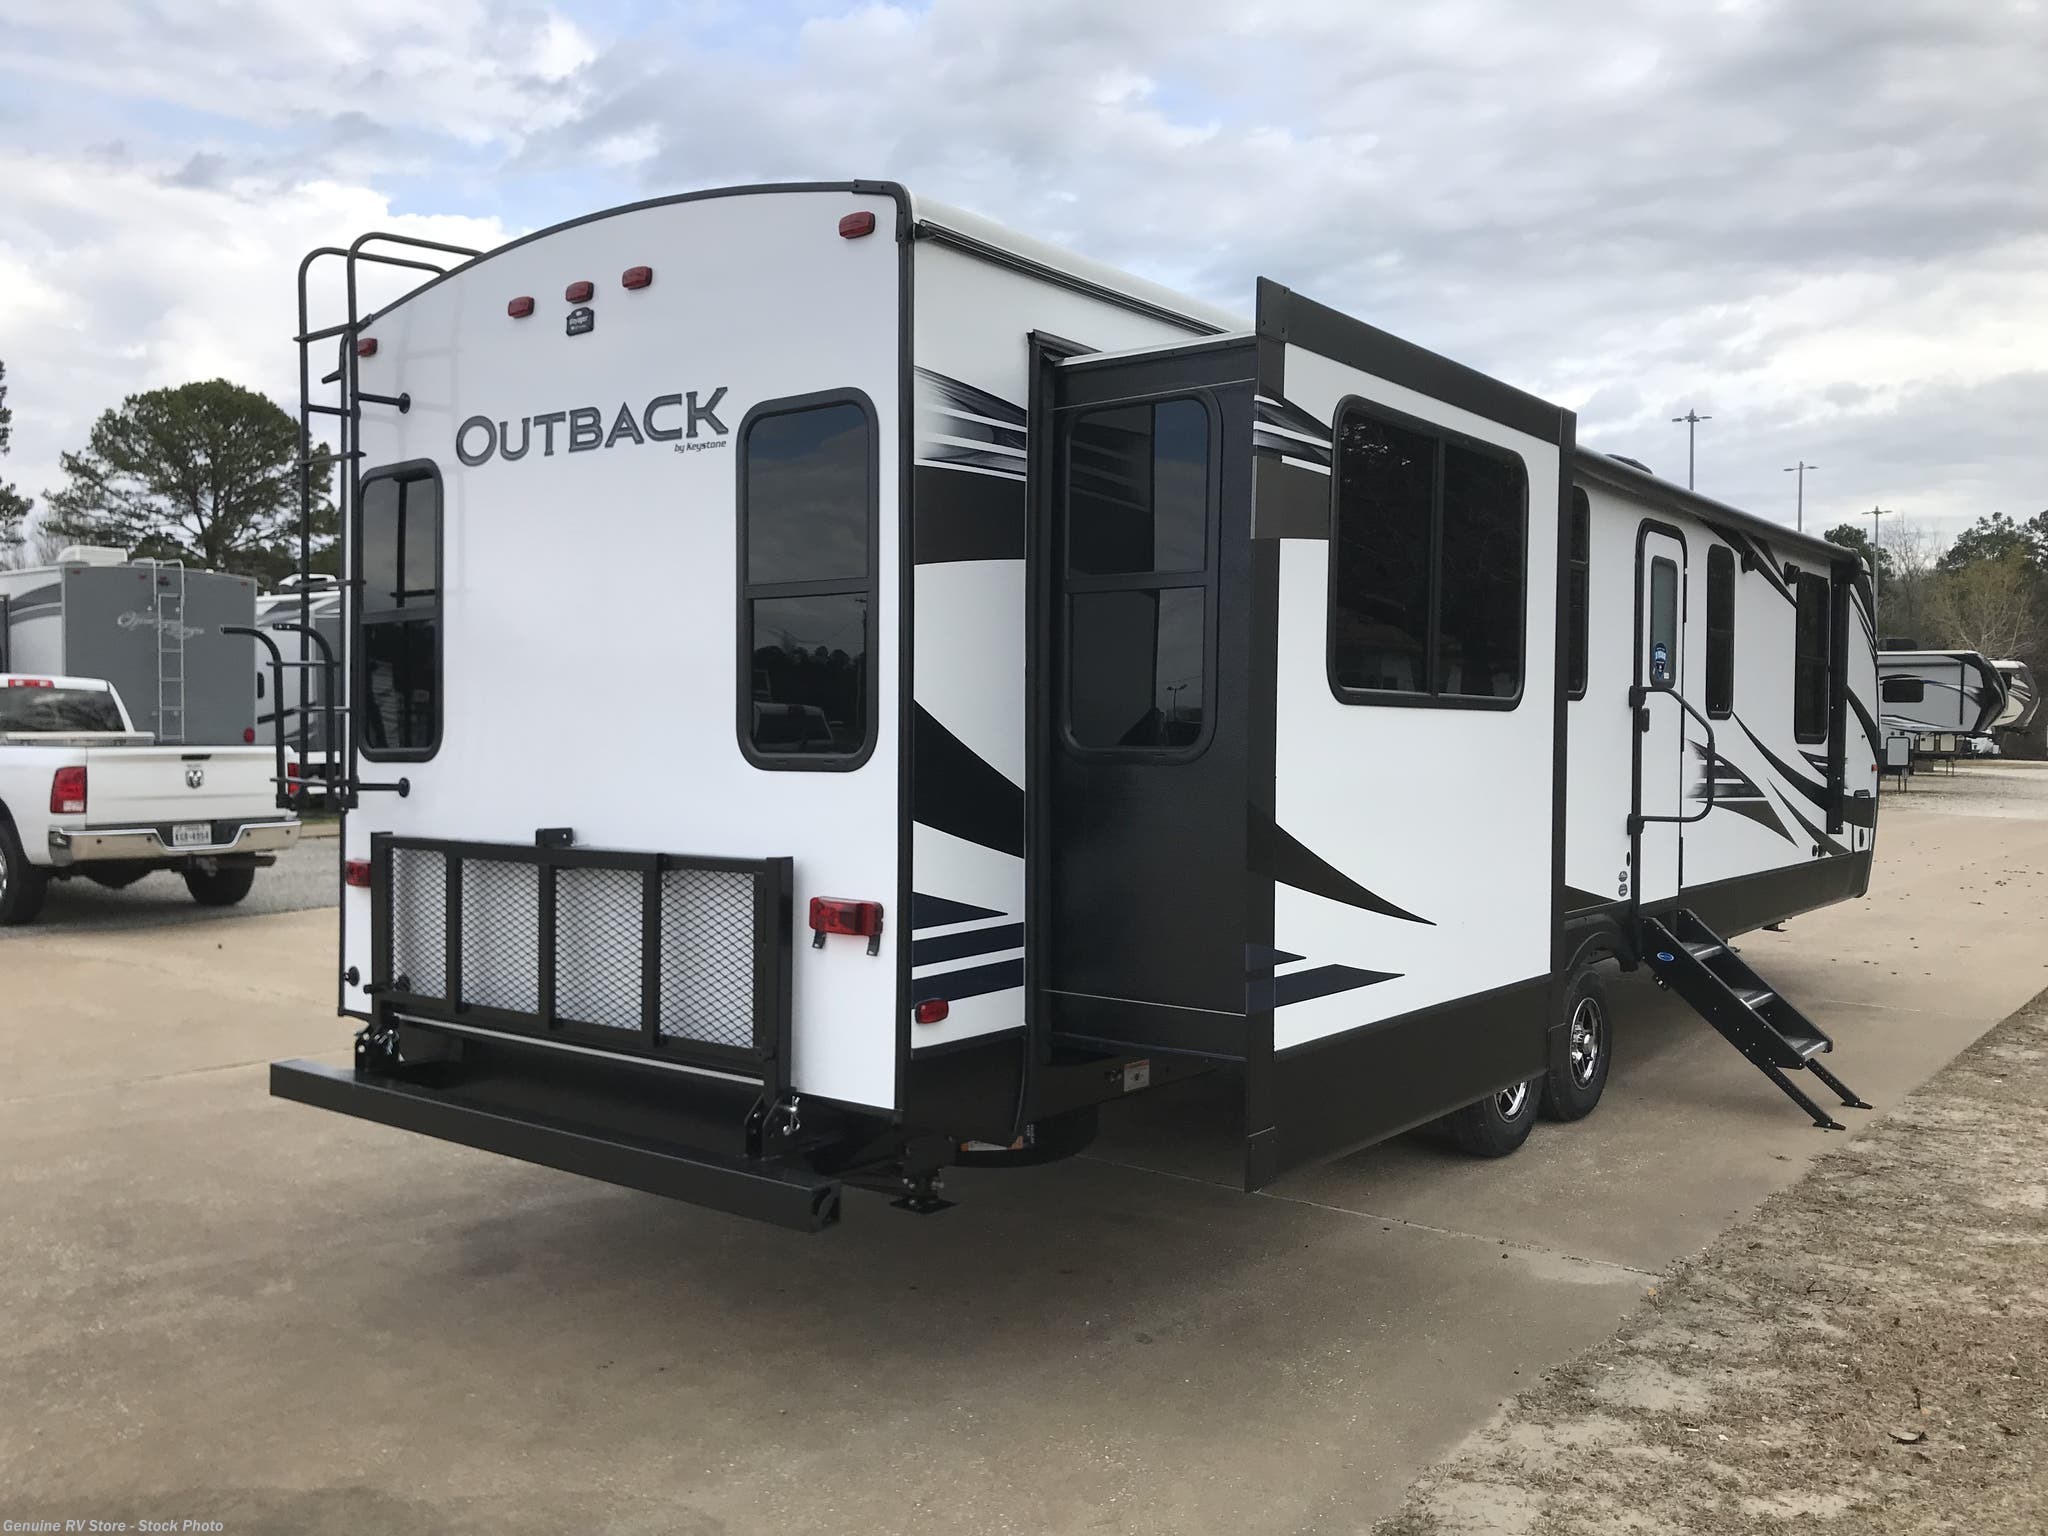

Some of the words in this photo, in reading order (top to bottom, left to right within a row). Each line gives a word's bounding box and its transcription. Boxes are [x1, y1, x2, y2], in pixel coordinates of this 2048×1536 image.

[456, 386, 728, 467] OUTBACK
[674, 443, 685, 454] by
[686, 440, 727, 452] Keystone
